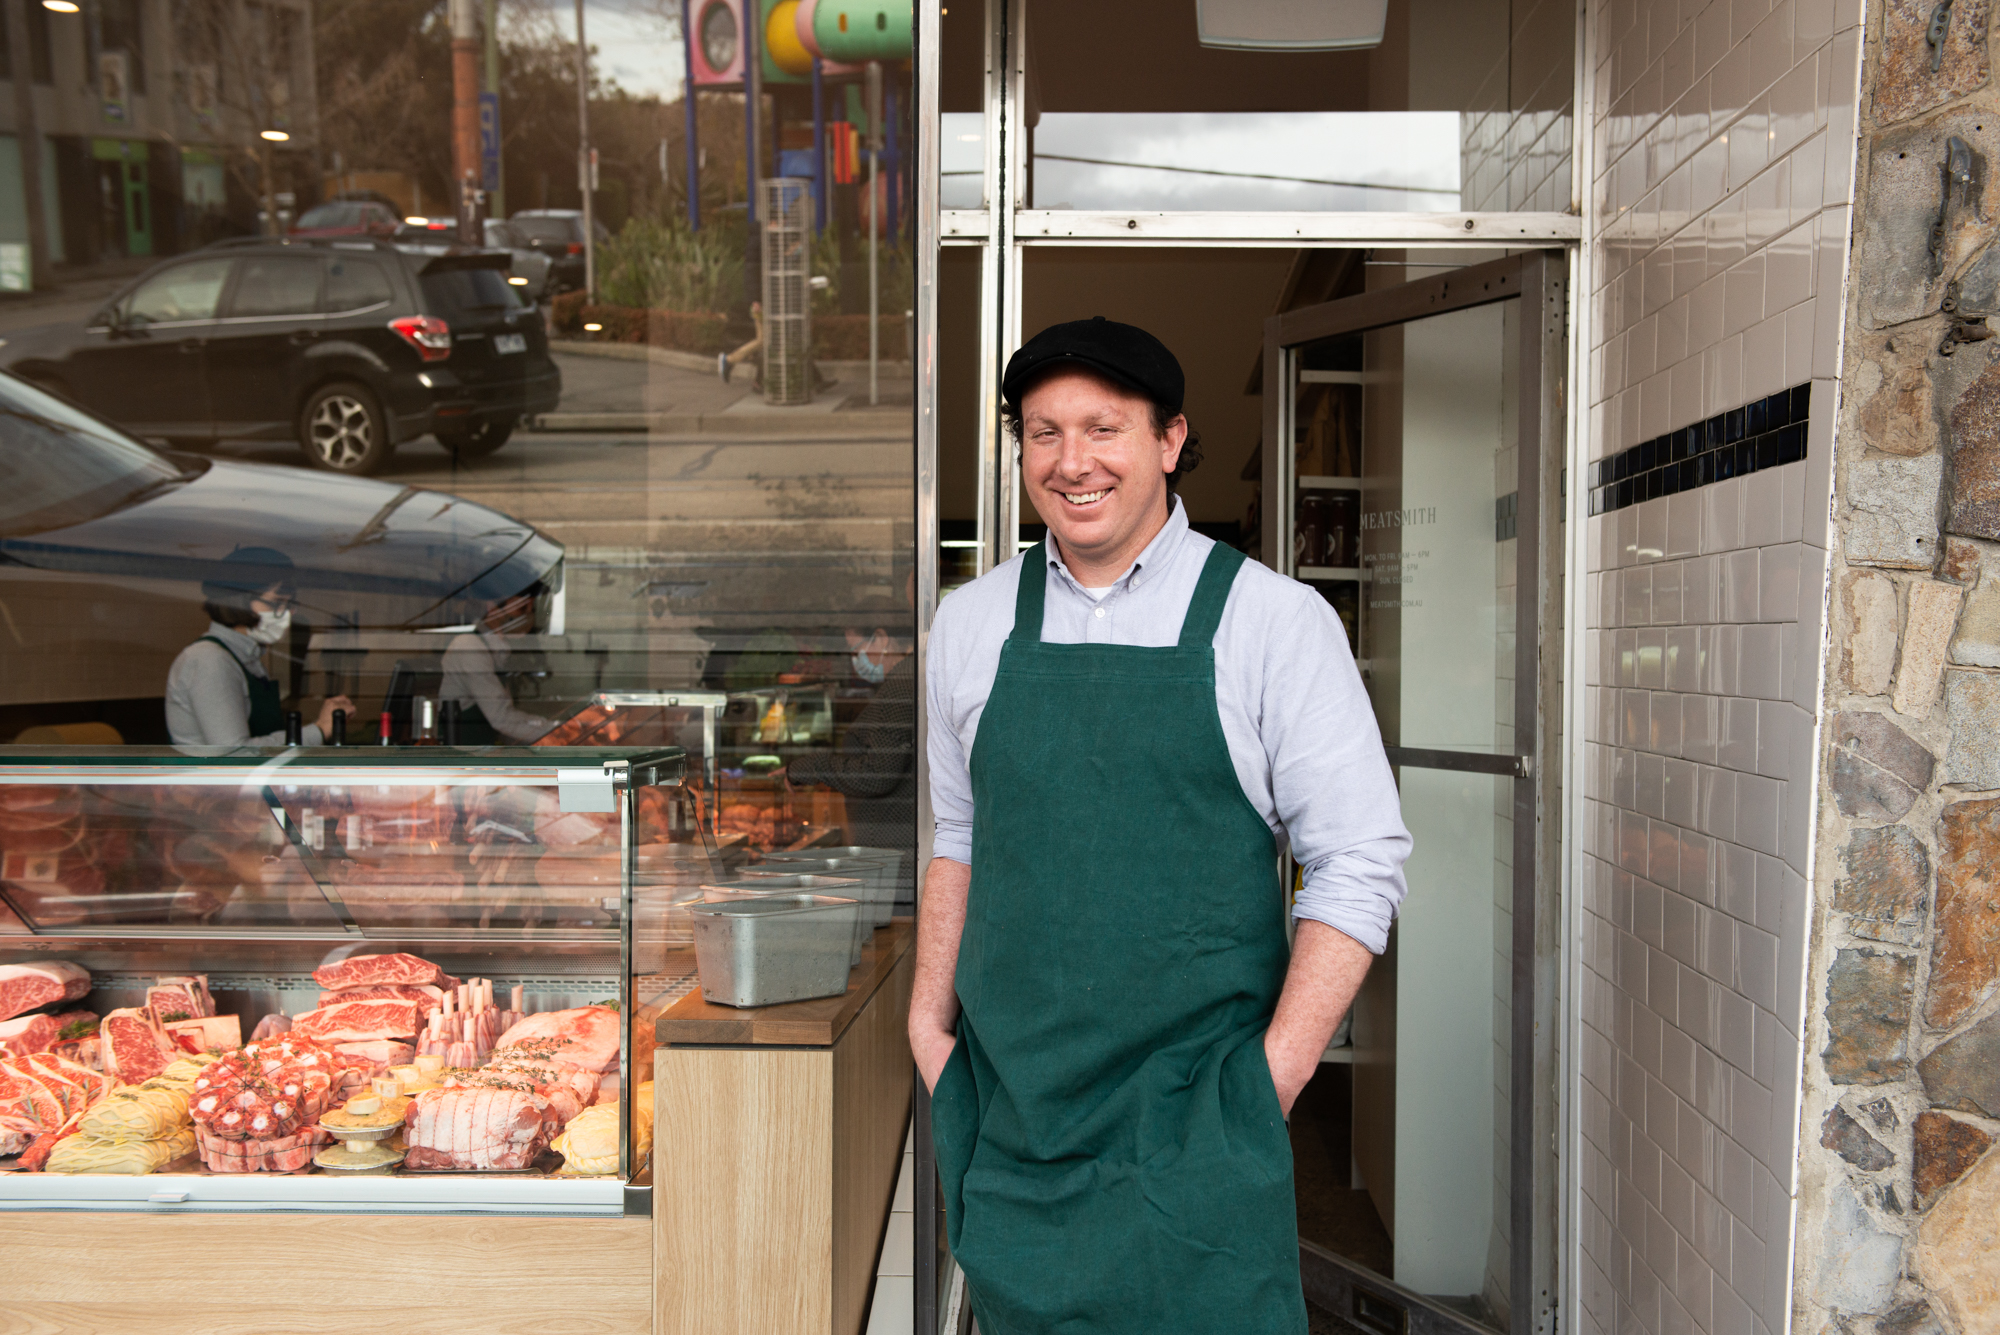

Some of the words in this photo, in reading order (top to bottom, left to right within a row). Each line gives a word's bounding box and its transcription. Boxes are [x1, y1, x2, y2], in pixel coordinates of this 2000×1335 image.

[1360, 507, 1436, 530] MEATSMITH
[1387, 564, 1399, 572] 9AM
[1393, 576, 1413, 584] CLOSED
